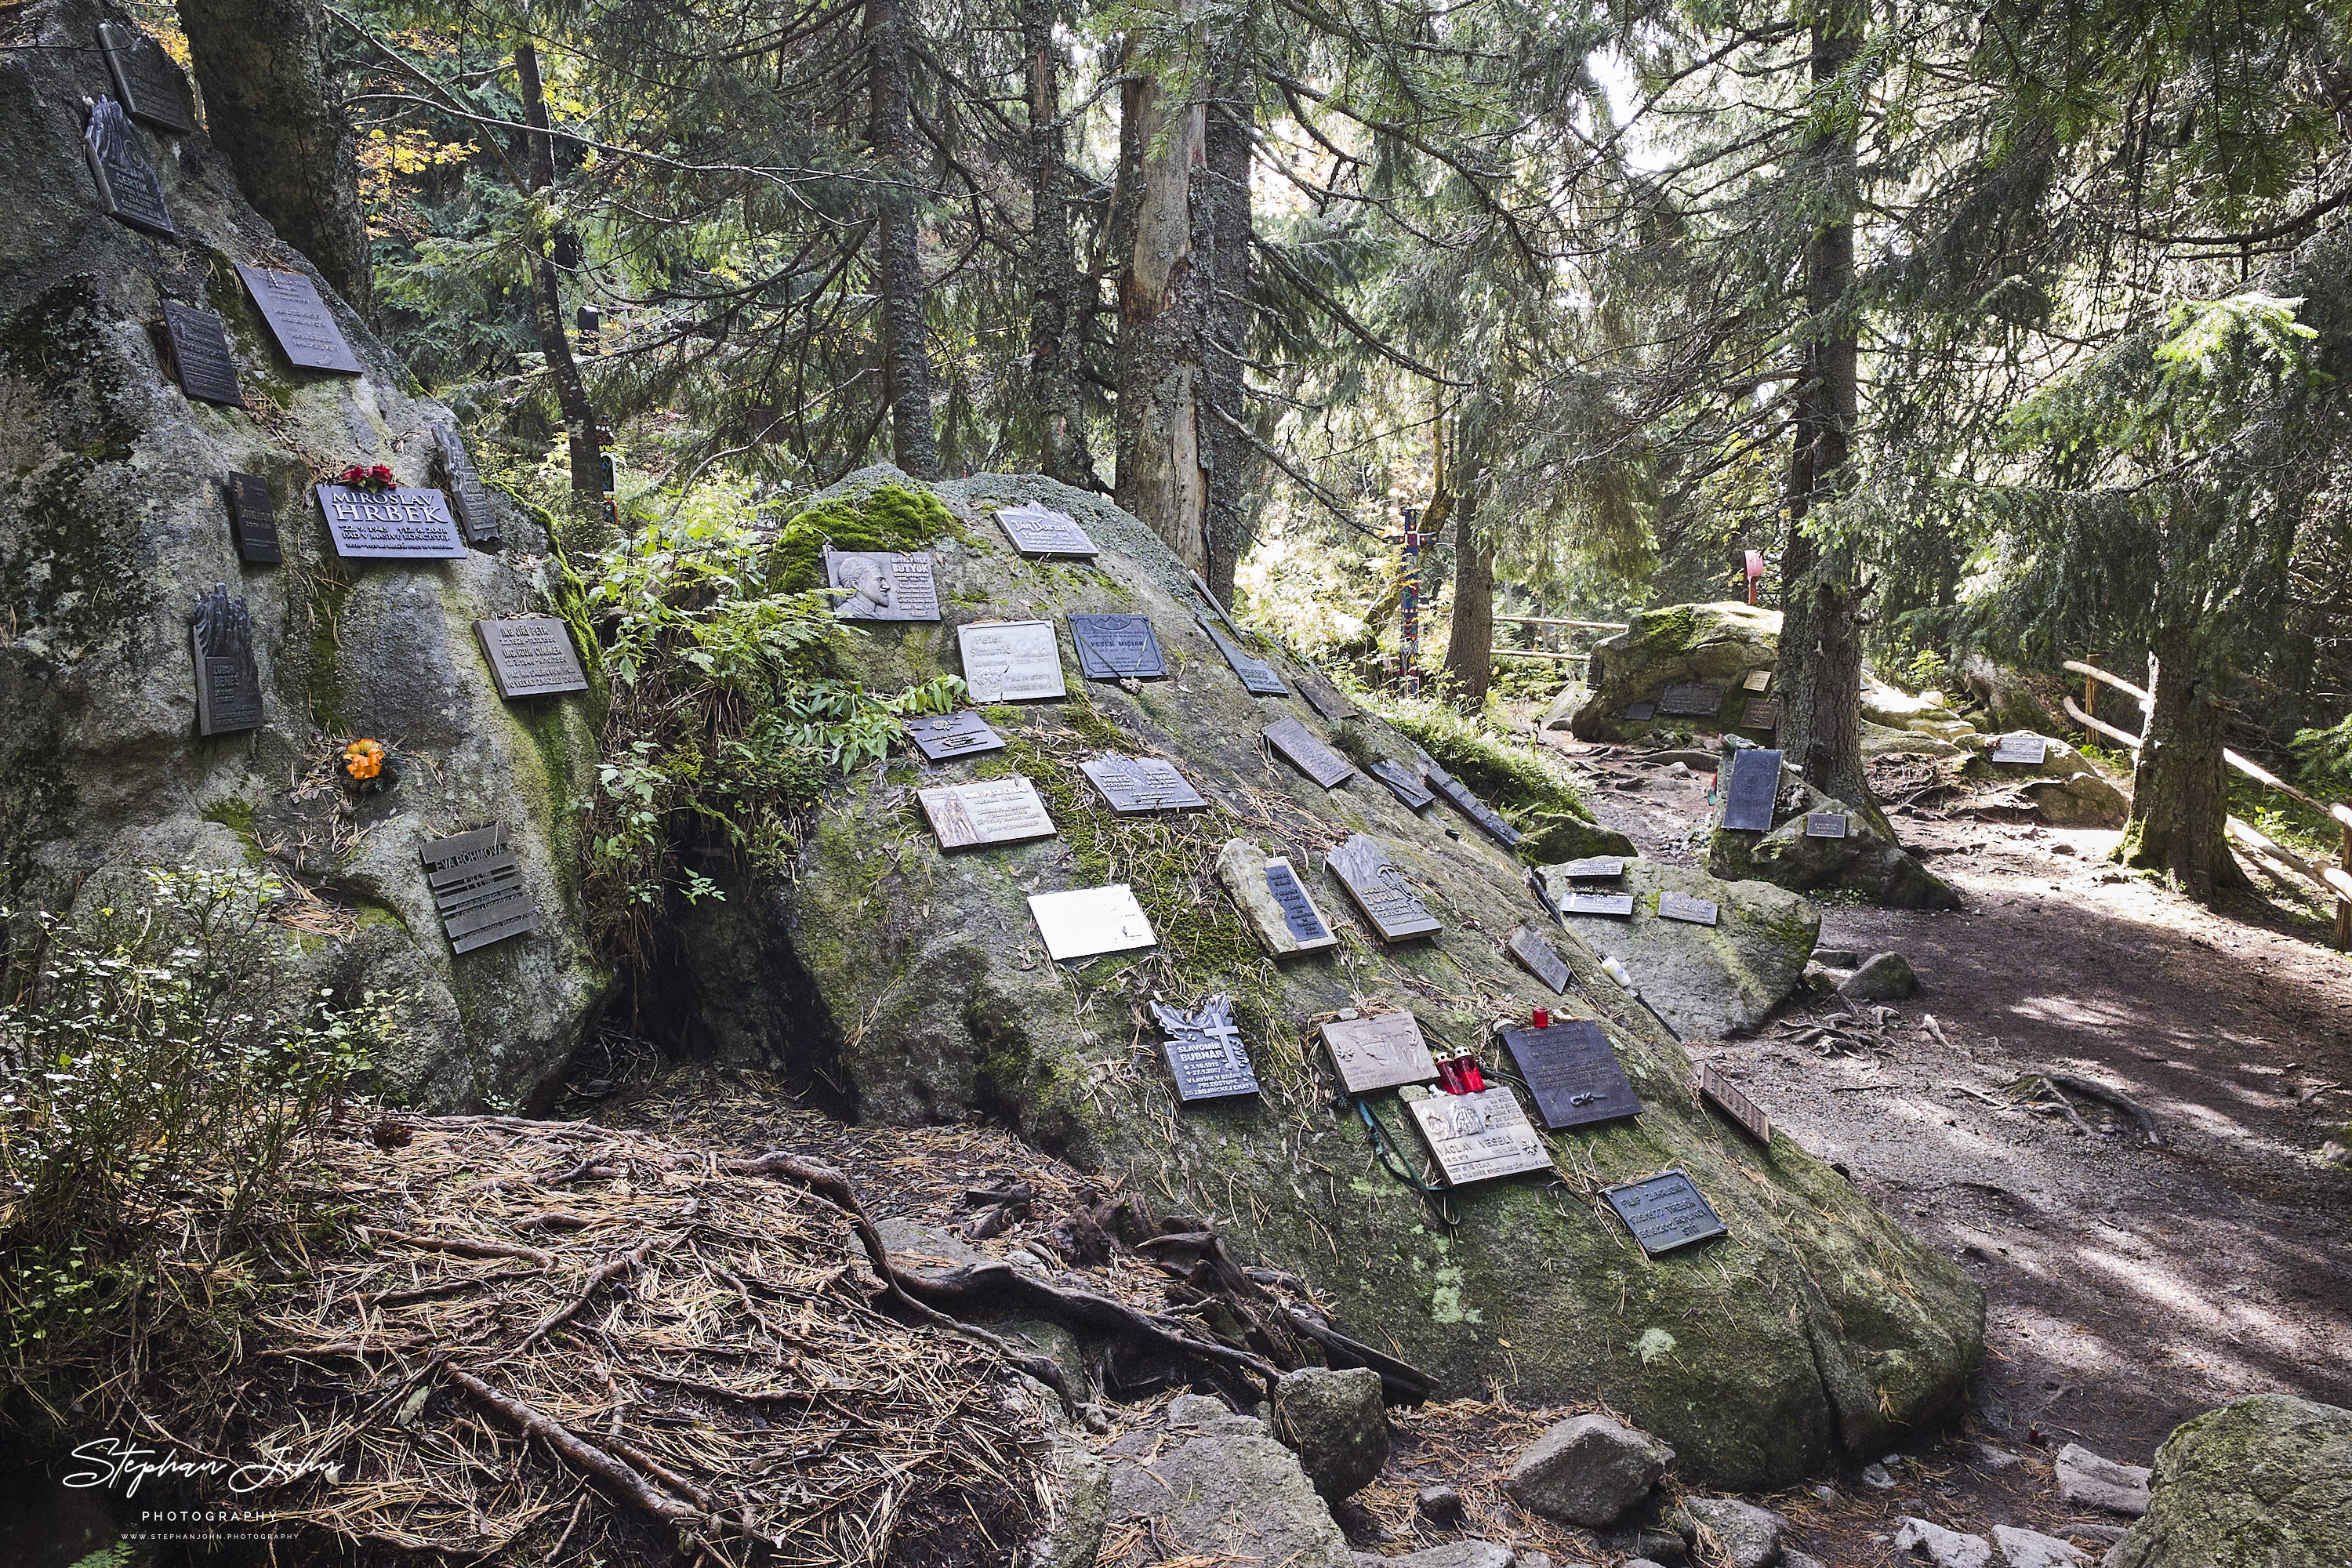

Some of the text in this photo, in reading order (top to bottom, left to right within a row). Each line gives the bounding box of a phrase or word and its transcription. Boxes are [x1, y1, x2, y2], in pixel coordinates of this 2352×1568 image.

[332, 492, 434, 506] MIROSLAV
[332, 503, 448, 524] HRBEK
[530, 626, 550, 636] PETR
[974, 634, 1003, 644] Peter
[982, 789, 1003, 797] PETR
[434, 858, 457, 872] EVA
[1177, 1042, 1221, 1054] SLAVOMÍR
[1179, 1049, 1225, 1063] BUBNÁR
[1210, 1079, 1240, 1087] ZOSTUPE
[1435, 1142, 1474, 1156] VÁCLAV
[1477, 1132, 1515, 1149] VESELÝ
[1620, 1196, 1642, 1208] FILIP
